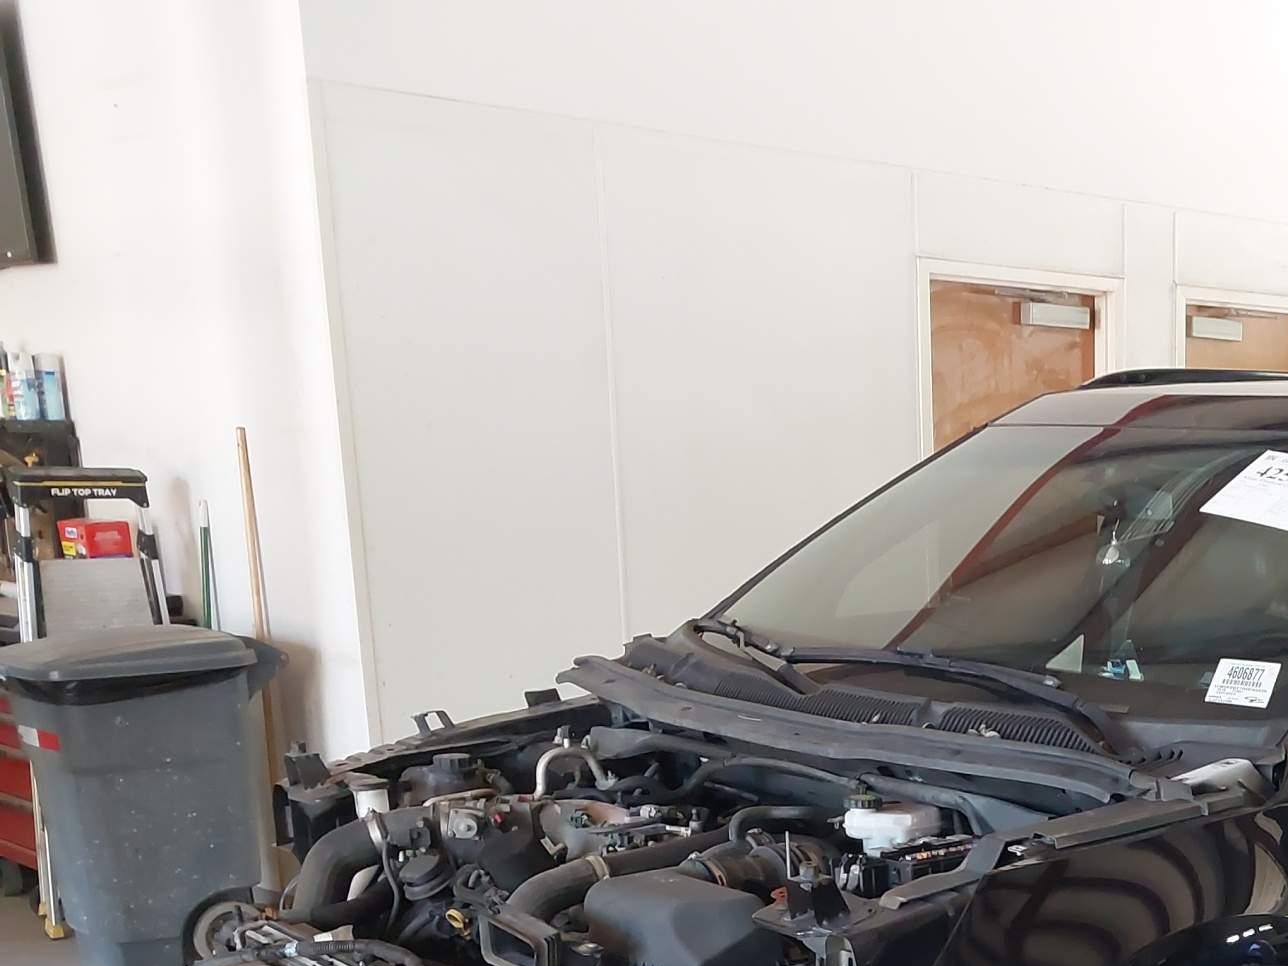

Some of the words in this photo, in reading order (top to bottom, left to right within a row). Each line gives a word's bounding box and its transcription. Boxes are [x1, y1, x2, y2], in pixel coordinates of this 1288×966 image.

[50, 487, 71, 497] FLIP
[72, 487, 92, 497] TOP
[93, 487, 117, 497] TRAY
[1227, 665, 1266, 681] 4606877
